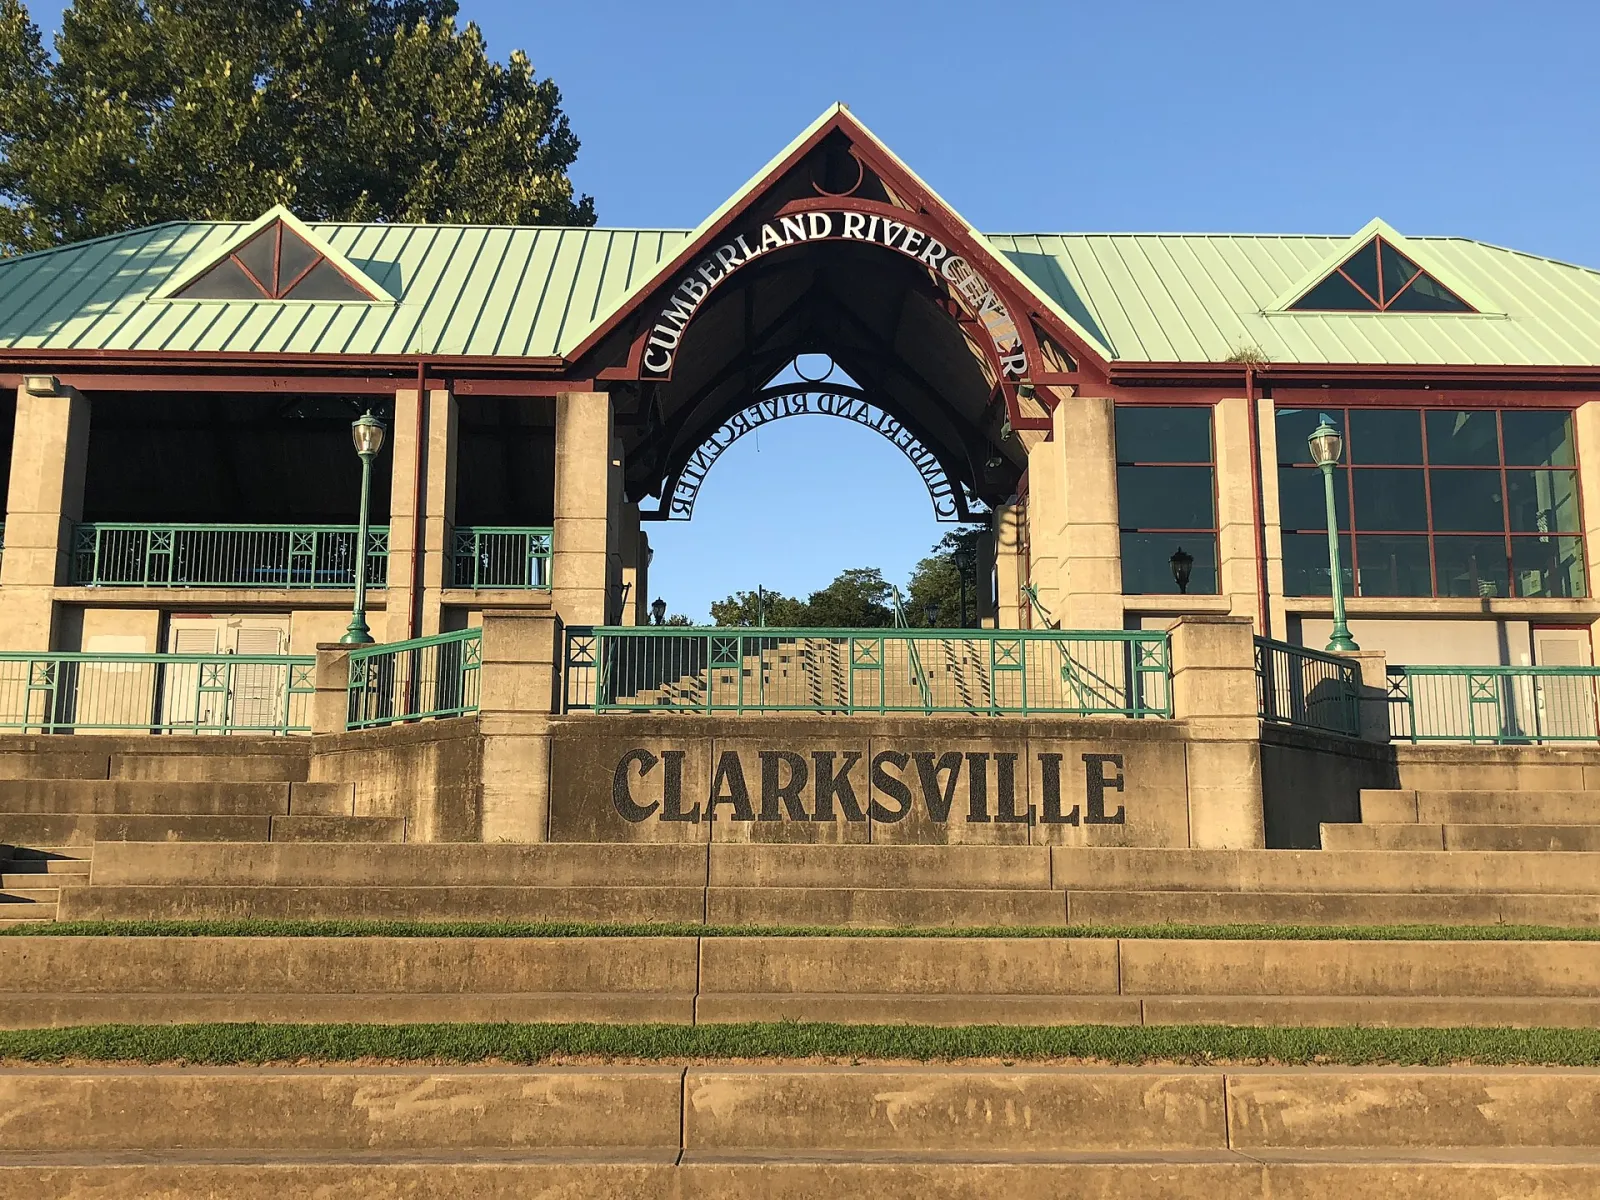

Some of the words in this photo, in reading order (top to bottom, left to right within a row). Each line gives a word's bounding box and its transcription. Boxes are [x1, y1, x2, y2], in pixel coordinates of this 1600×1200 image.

[644, 212, 832, 372] CUMBERLAND
[842, 212, 1028, 377] RIVERCENTER
[612, 748, 1125, 827] CLARKSVILLE
